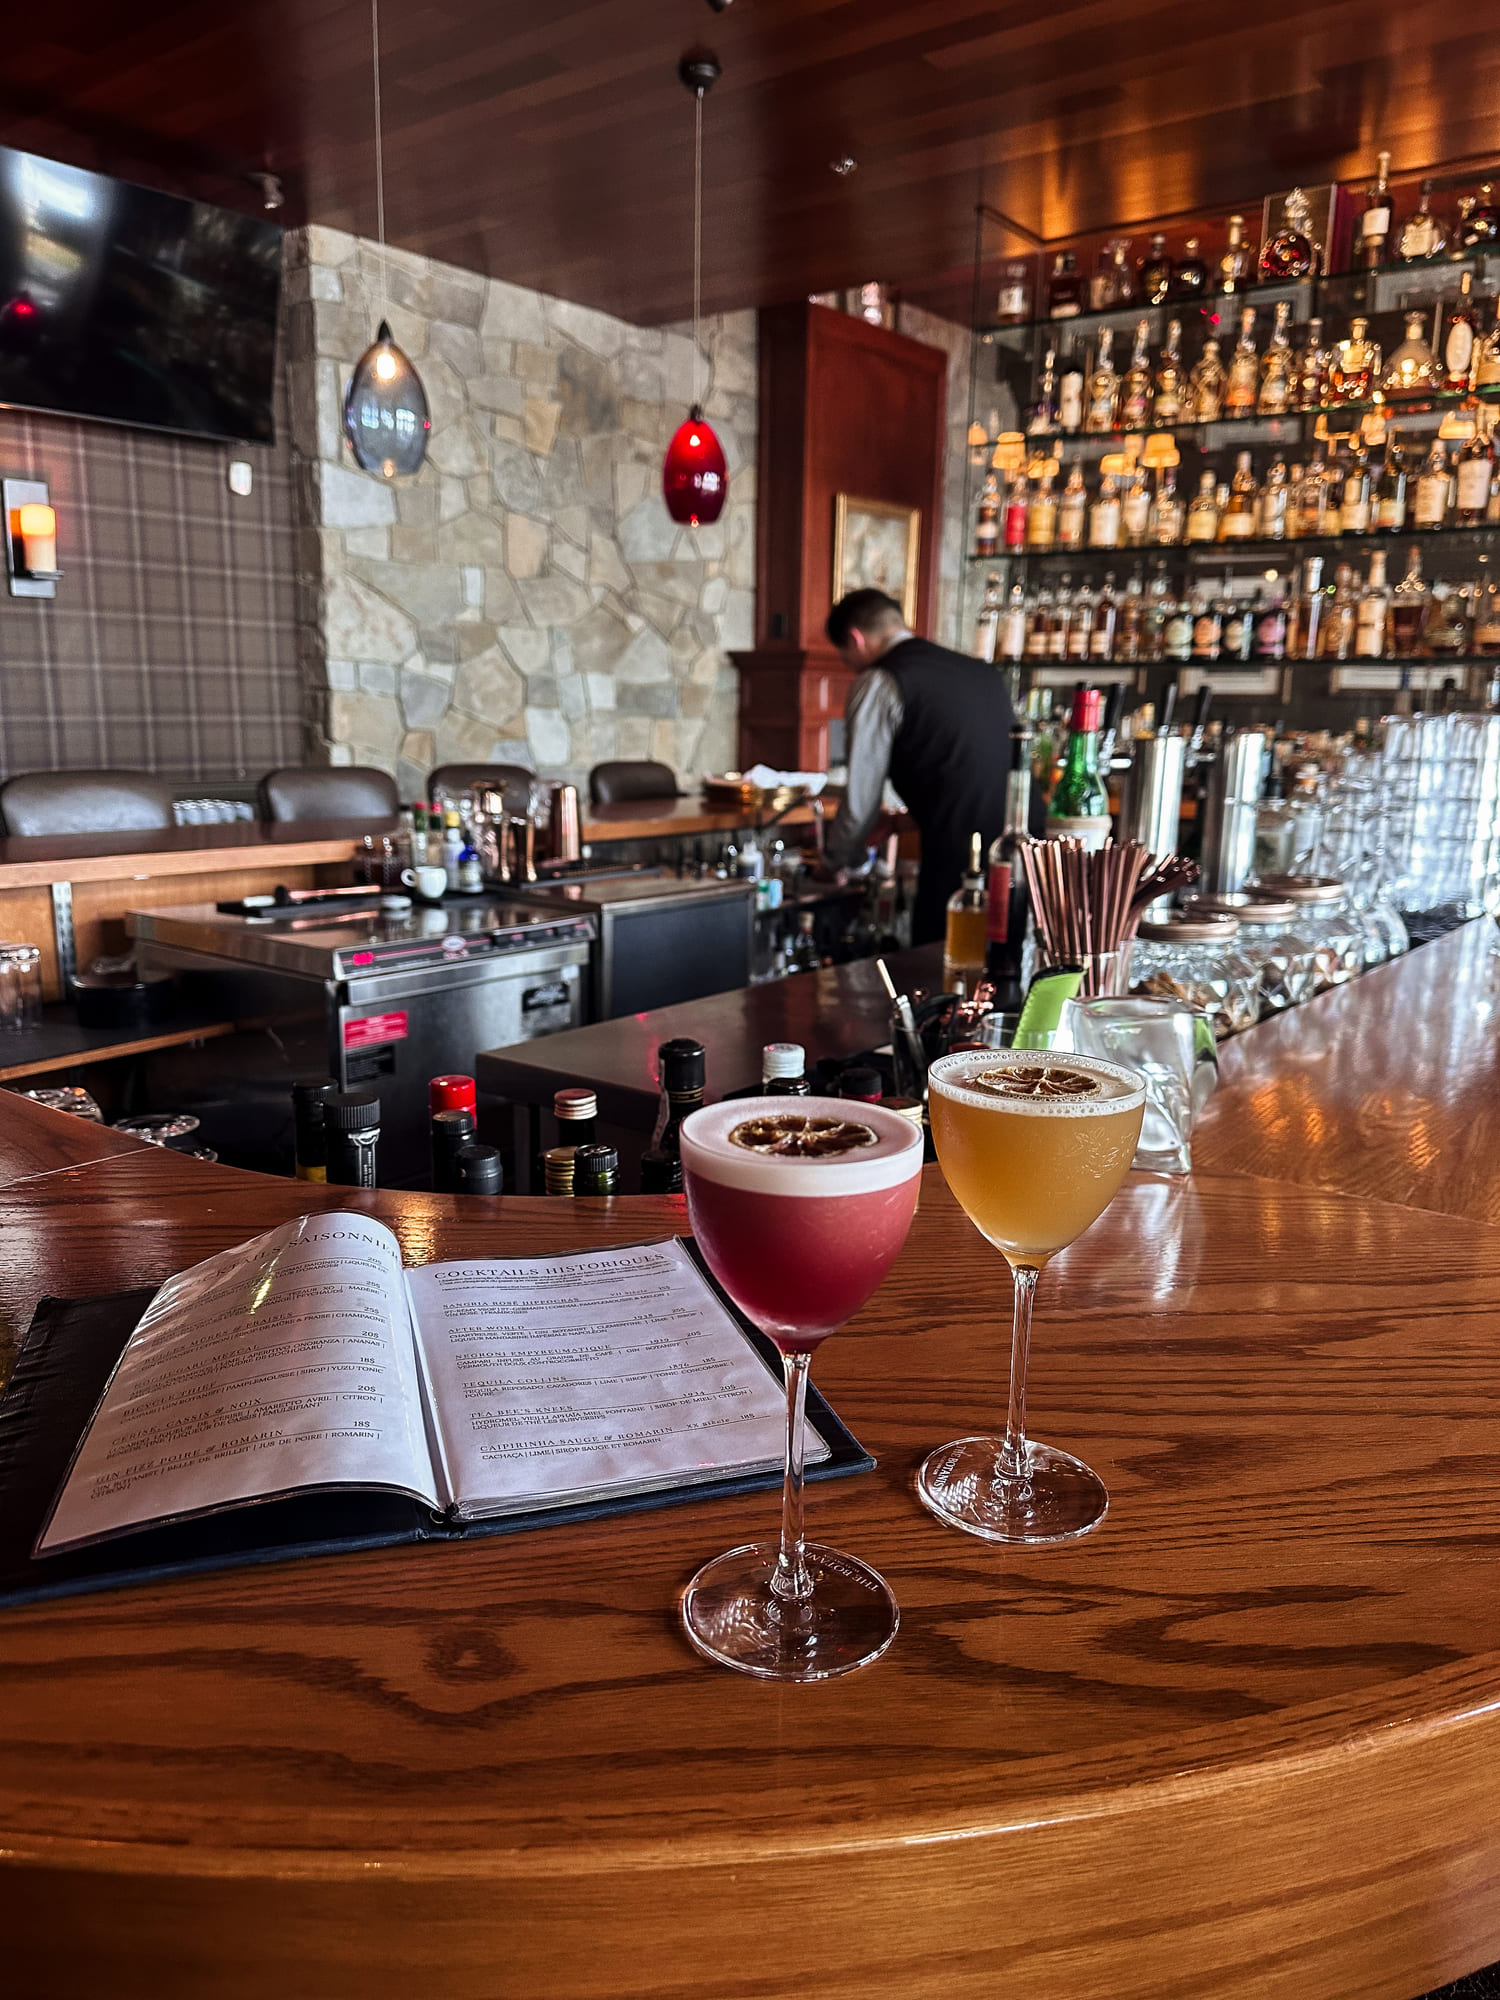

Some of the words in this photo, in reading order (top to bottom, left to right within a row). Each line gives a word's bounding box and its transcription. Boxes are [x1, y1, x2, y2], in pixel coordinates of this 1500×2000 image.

[434, 1268, 539, 1279] COCKTAILS
[546, 1253, 665, 1275] HISTORIQUES
[335, 1313, 386, 1324] CHAMPAGNE
[348, 1338, 380, 1347] ANANAS
[361, 1330, 379, 1338] 20$
[456, 1351, 507, 1359] NEGRONI
[511, 1345, 612, 1356] EMPYREUMATIQUE
[681, 1362, 729, 1374] CONCOMBRE
[226, 1372, 296, 1390] PAMPLEMOUSSE
[300, 1367, 326, 1375] SIROP
[357, 1366, 384, 1374] TONIC
[462, 1380, 513, 1388] TEQUILA
[230, 1397, 262, 1410] NOIX
[471, 1417, 520, 1426] HYDROMEL
[718, 1390, 747, 1399] CITRON
[472, 1422, 510, 1430] LIQUEUR
[221, 1430, 284, 1449] ROMARIN
[259, 1442, 275, 1450] JUS
[295, 1433, 323, 1442] POIRE
[480, 1439, 555, 1452] CAIPIRINHA
[559, 1436, 600, 1445] SAUGE
[618, 1426, 673, 1440] ROMARIN
[482, 1452, 523, 1460] CACHAÇA
[555, 1446, 580, 1454] SIROP
[623, 1437, 662, 1448] ROMARIN
[804, 1551, 852, 1577] BOTANI
[852, 1575, 879, 1592] THE
